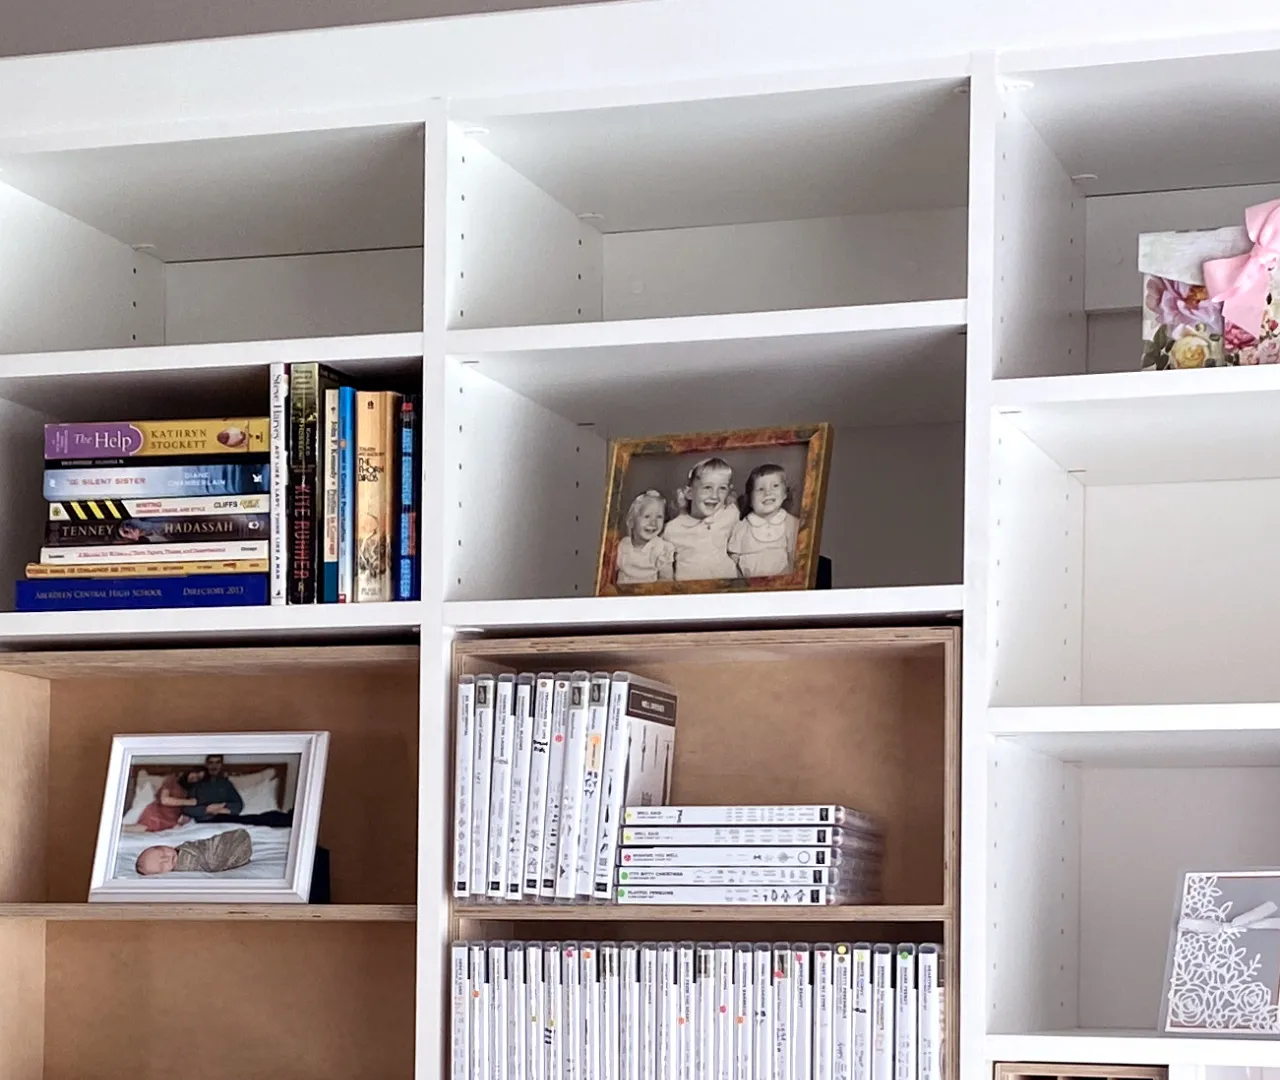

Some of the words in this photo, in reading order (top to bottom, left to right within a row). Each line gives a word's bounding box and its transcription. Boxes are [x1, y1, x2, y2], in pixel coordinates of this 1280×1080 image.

[273, 374, 282, 402] Steve
[272, 405, 282, 440] Harvey
[74, 433, 92, 444] The
[95, 431, 131, 451] Help
[151, 429, 206, 438] KATHRYN
[151, 441, 205, 449] STOCKETT
[330, 449, 338, 479] Kennedy
[295, 485, 311, 517] KITE
[62, 525, 114, 536] TENNEY
[164, 522, 233, 533] HADASSAH
[294, 521, 310, 579] RUNNER
[74, 590, 107, 598] CENTRAL
[109, 589, 130, 597] HIGH
[133, 588, 163, 597] SCHOOL
[183, 587, 224, 596] DIRECTORY
[226, 586, 243, 594] 2013
